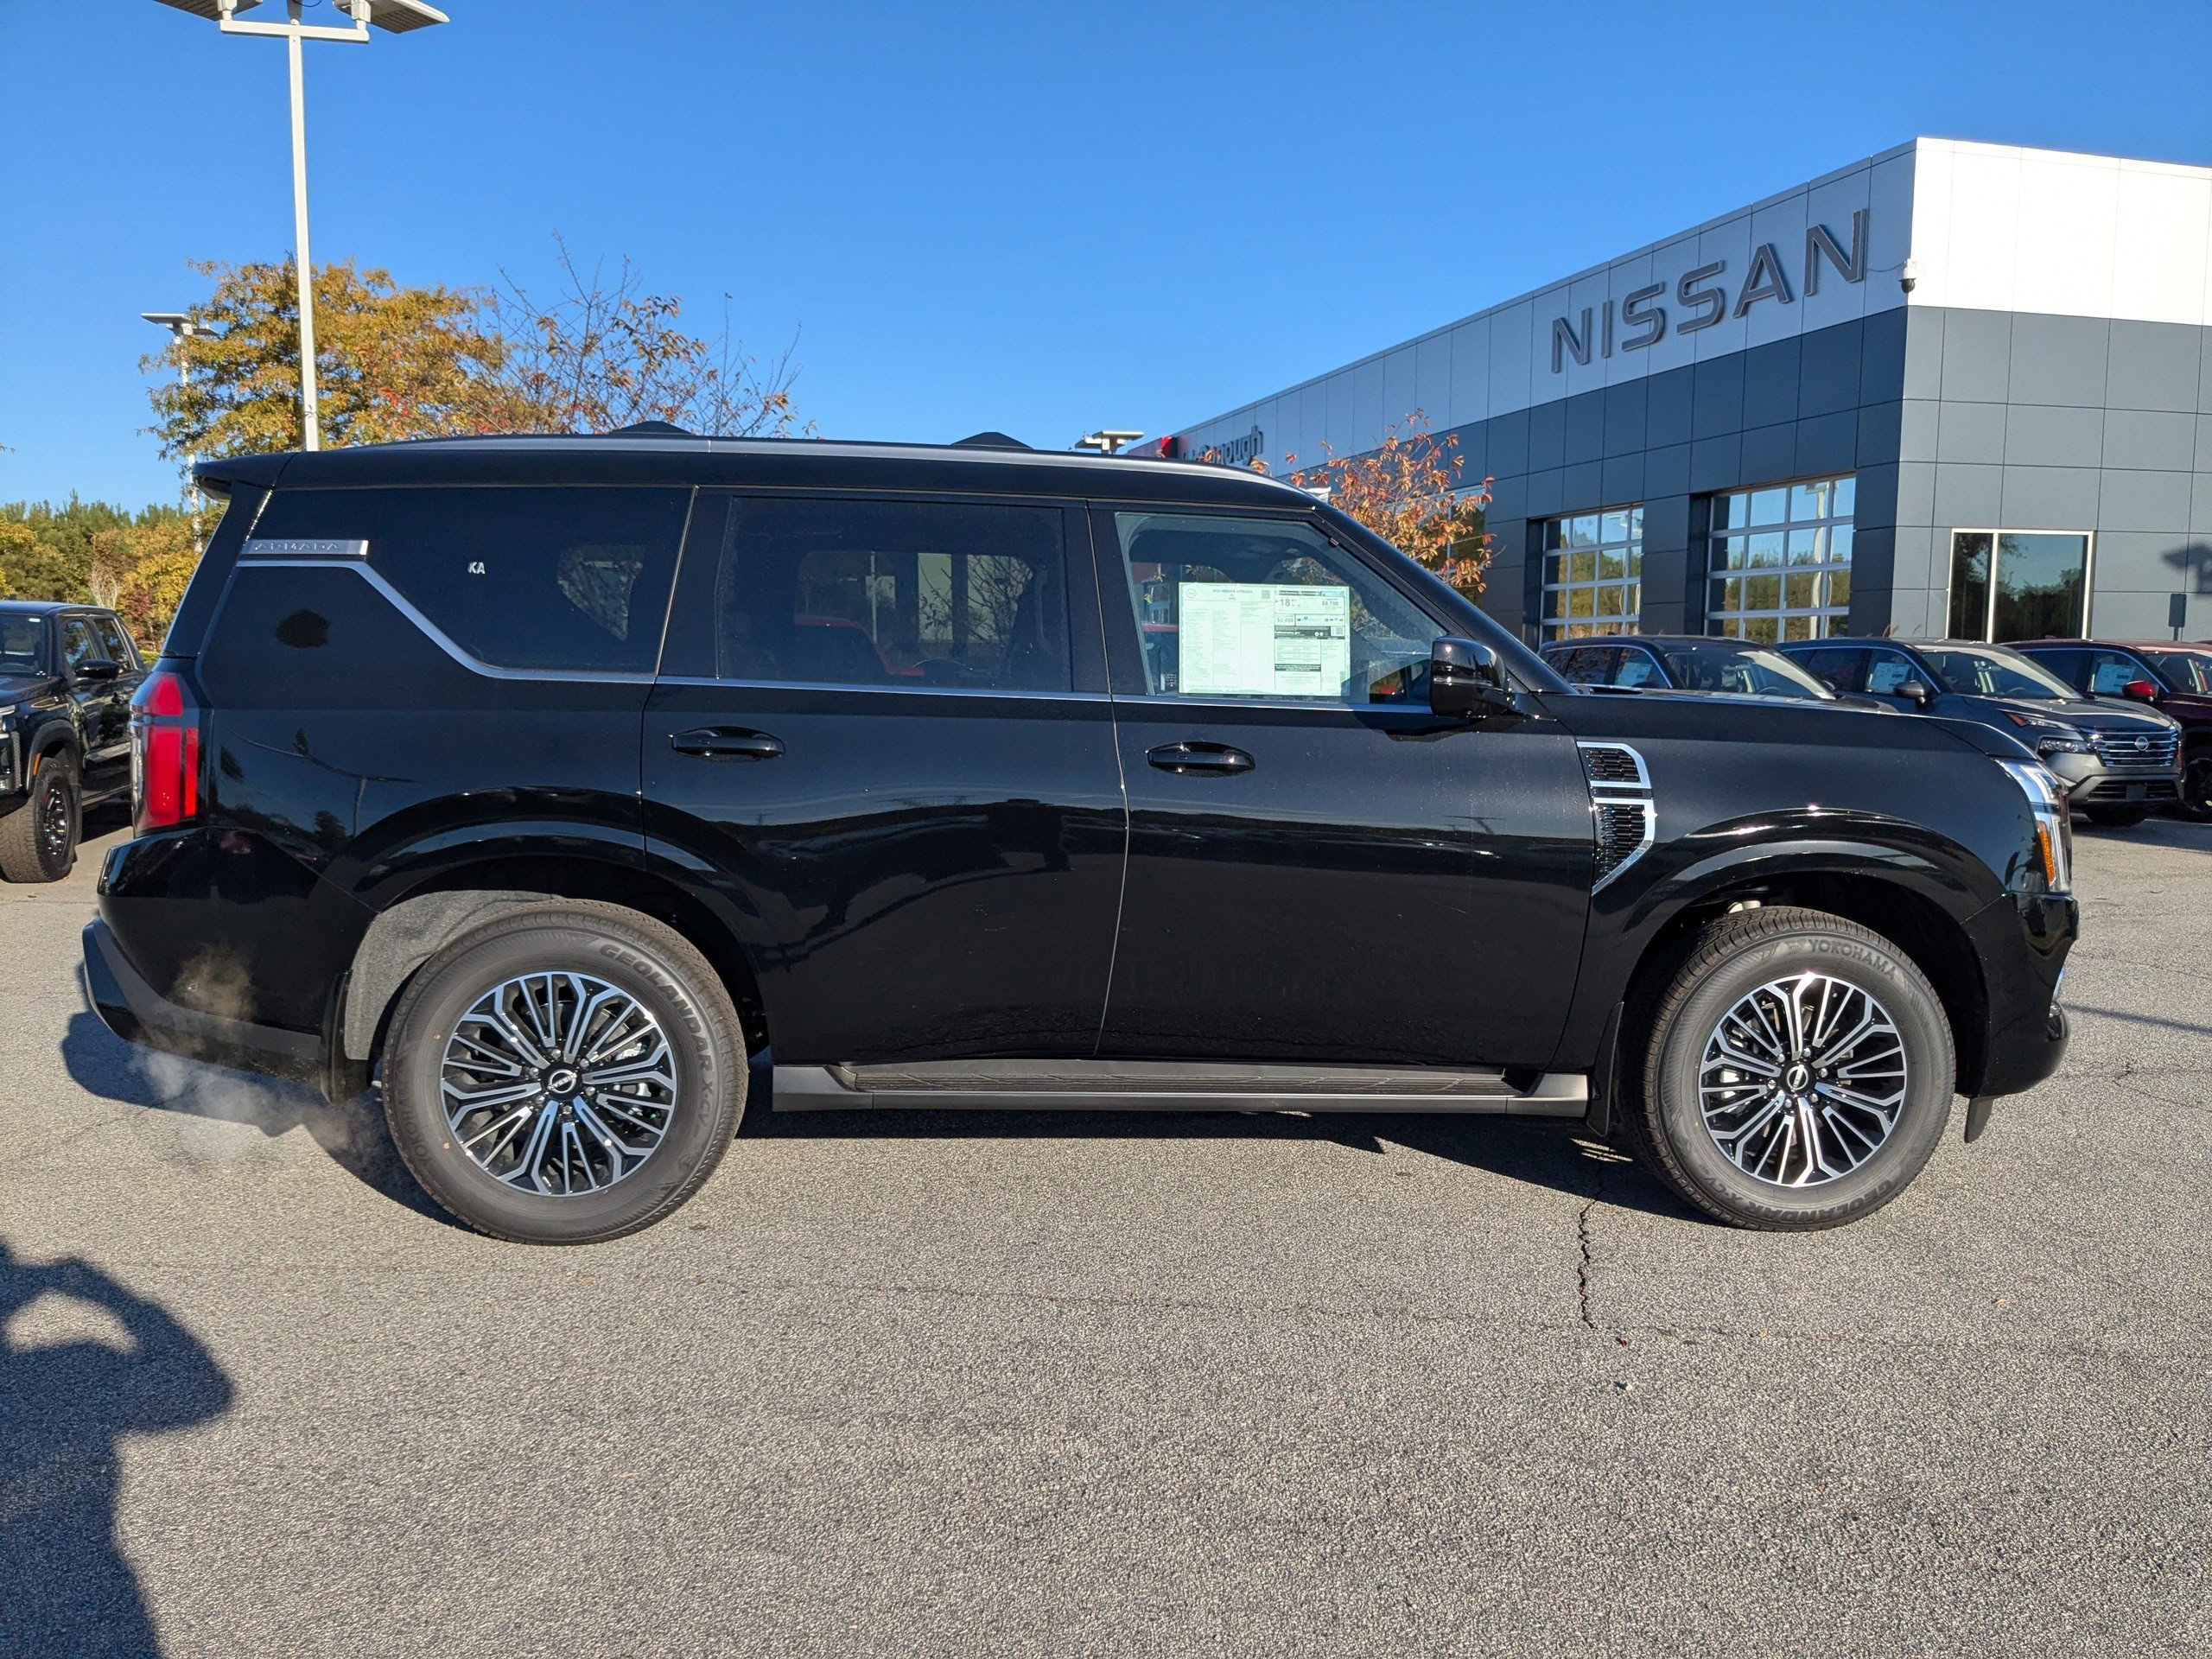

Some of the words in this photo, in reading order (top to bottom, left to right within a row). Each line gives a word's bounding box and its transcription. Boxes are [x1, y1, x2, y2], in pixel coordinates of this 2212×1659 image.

[1551, 208, 1867, 373] NISSAN
[467, 562, 486, 575] KA
[1808, 938, 1897, 980] YOKOHAMA
[599, 943, 715, 1073] GEOLANDAR
[1747, 1179, 1896, 1224] GEOLANDAR
